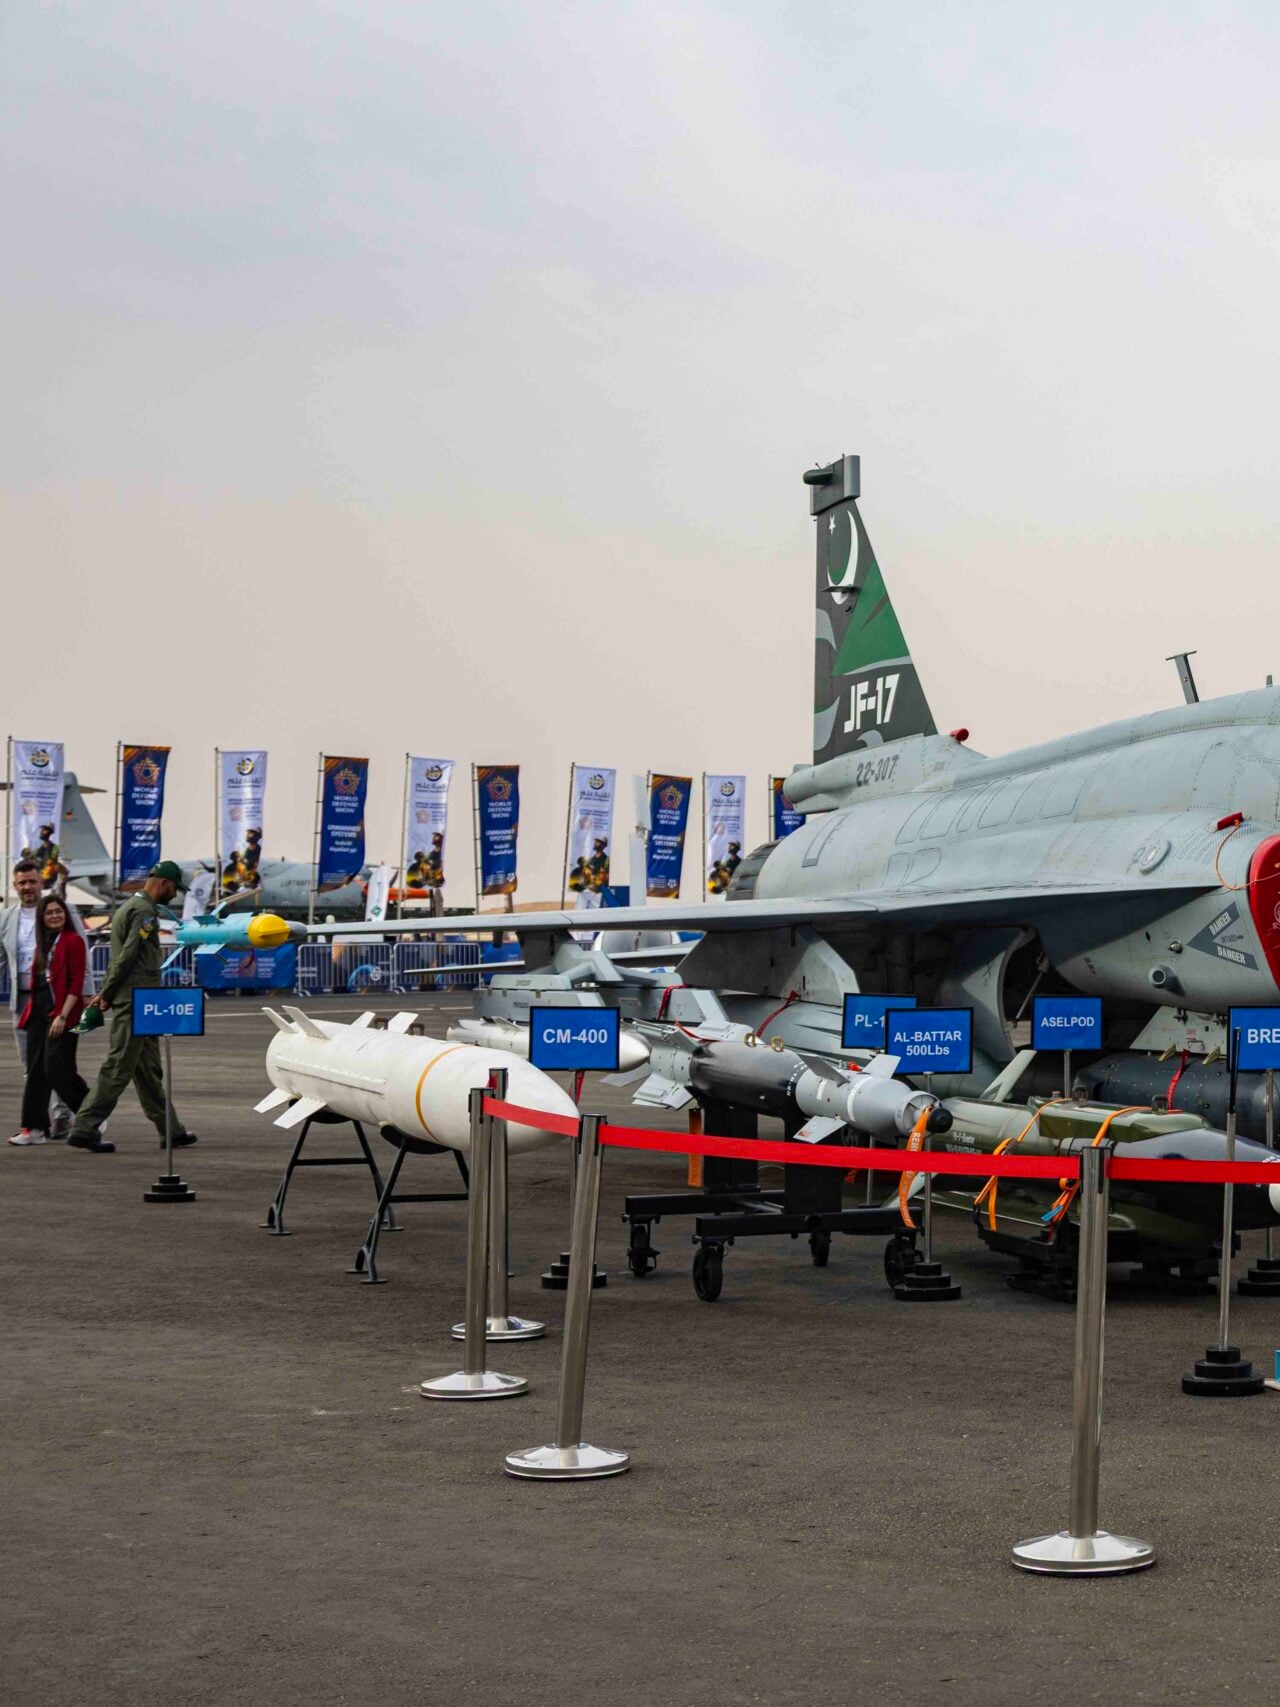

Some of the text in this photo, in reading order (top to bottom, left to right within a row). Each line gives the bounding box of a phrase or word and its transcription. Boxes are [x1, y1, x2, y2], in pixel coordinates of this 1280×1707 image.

[844, 673, 900, 734] JF-17
[856, 754, 900, 788] 22-307
[1209, 911, 1232, 936] DANGER
[1217, 945, 1246, 965] DANGER
[143, 1003, 194, 1016] PL-10E
[854, 1014, 885, 1028] PL-1
[1041, 1016, 1095, 1027] ASELPOD
[543, 1028, 608, 1044] CM-400
[894, 1031, 962, 1042] AL-BATTAR
[906, 1045, 950, 1056] 500Lbs
